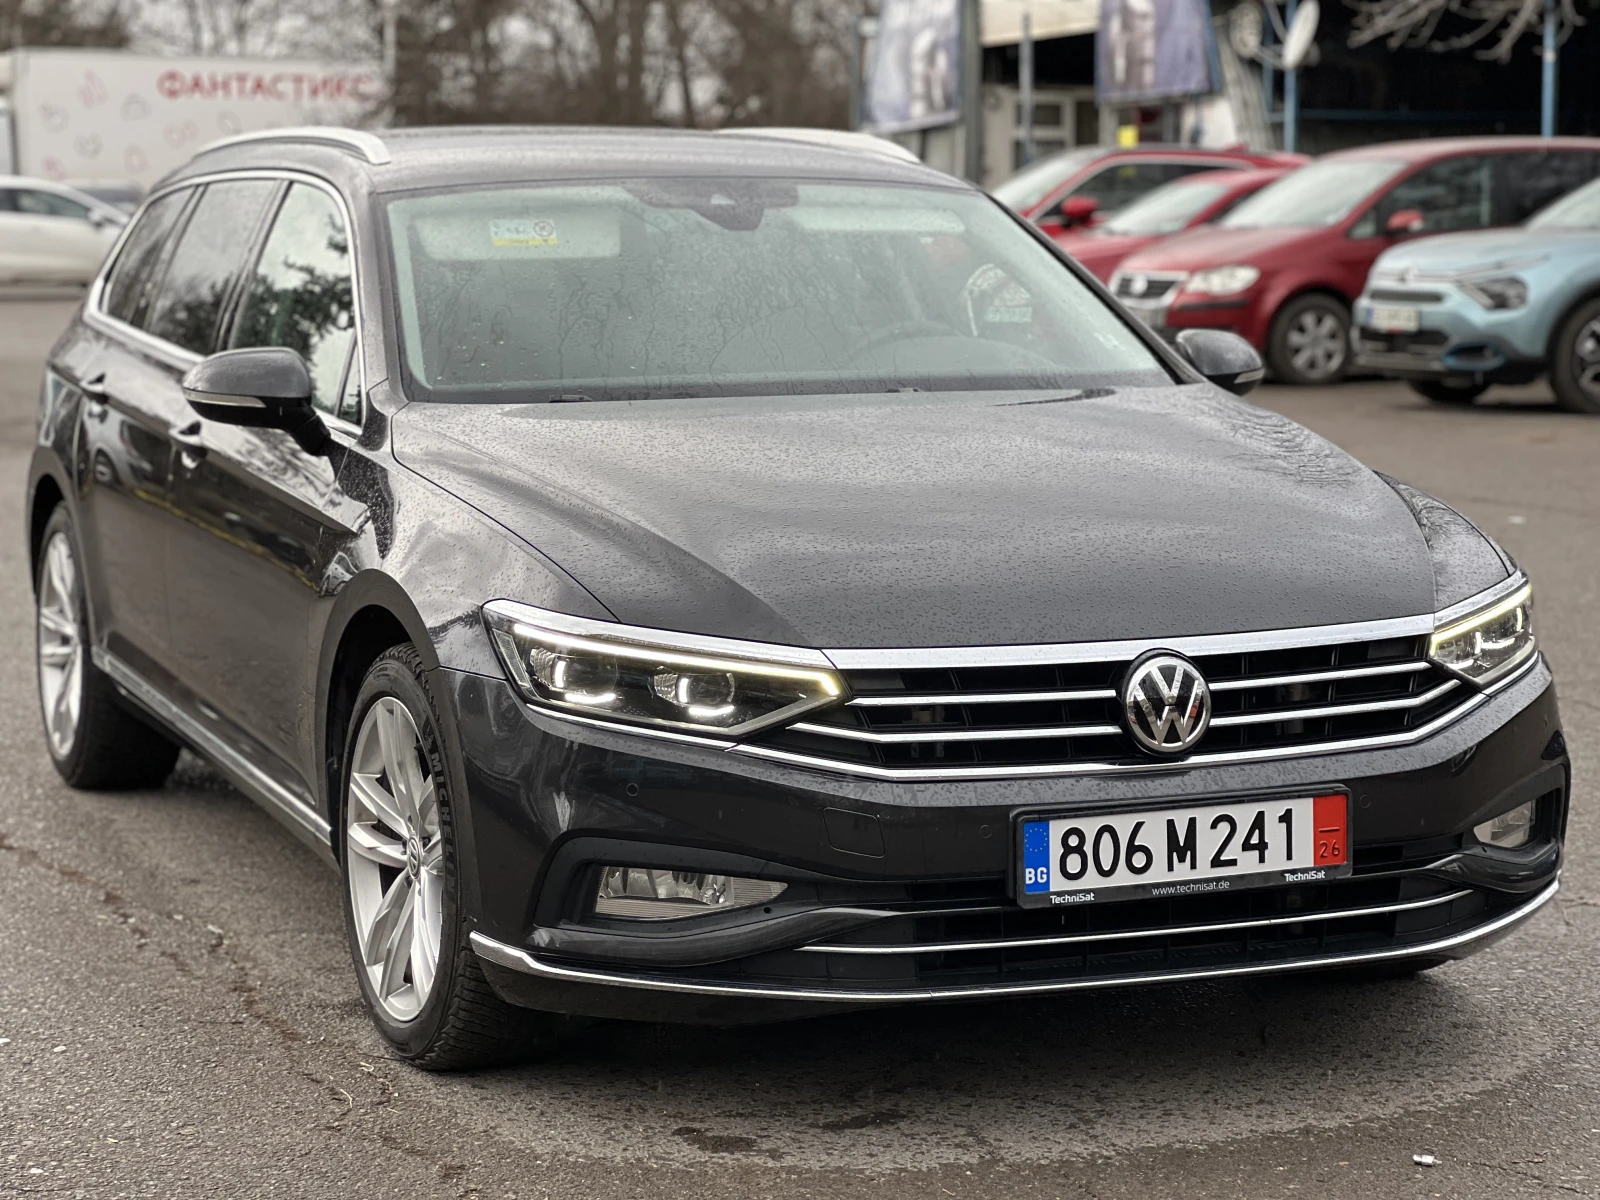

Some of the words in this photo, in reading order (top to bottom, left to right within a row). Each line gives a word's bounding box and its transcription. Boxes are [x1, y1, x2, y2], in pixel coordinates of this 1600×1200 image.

[430, 752, 456, 894] MICHELIN
[1058, 821, 1154, 881] 806
[1166, 816, 1198, 872] M
[1210, 808, 1293, 868] 241
[1319, 840, 1340, 859] 26
[1025, 867, 1047, 884] BG
[1284, 870, 1326, 882] TechniSat
[1152, 880, 1230, 895] www.technisat.de
[1050, 892, 1095, 904] TechniSat
